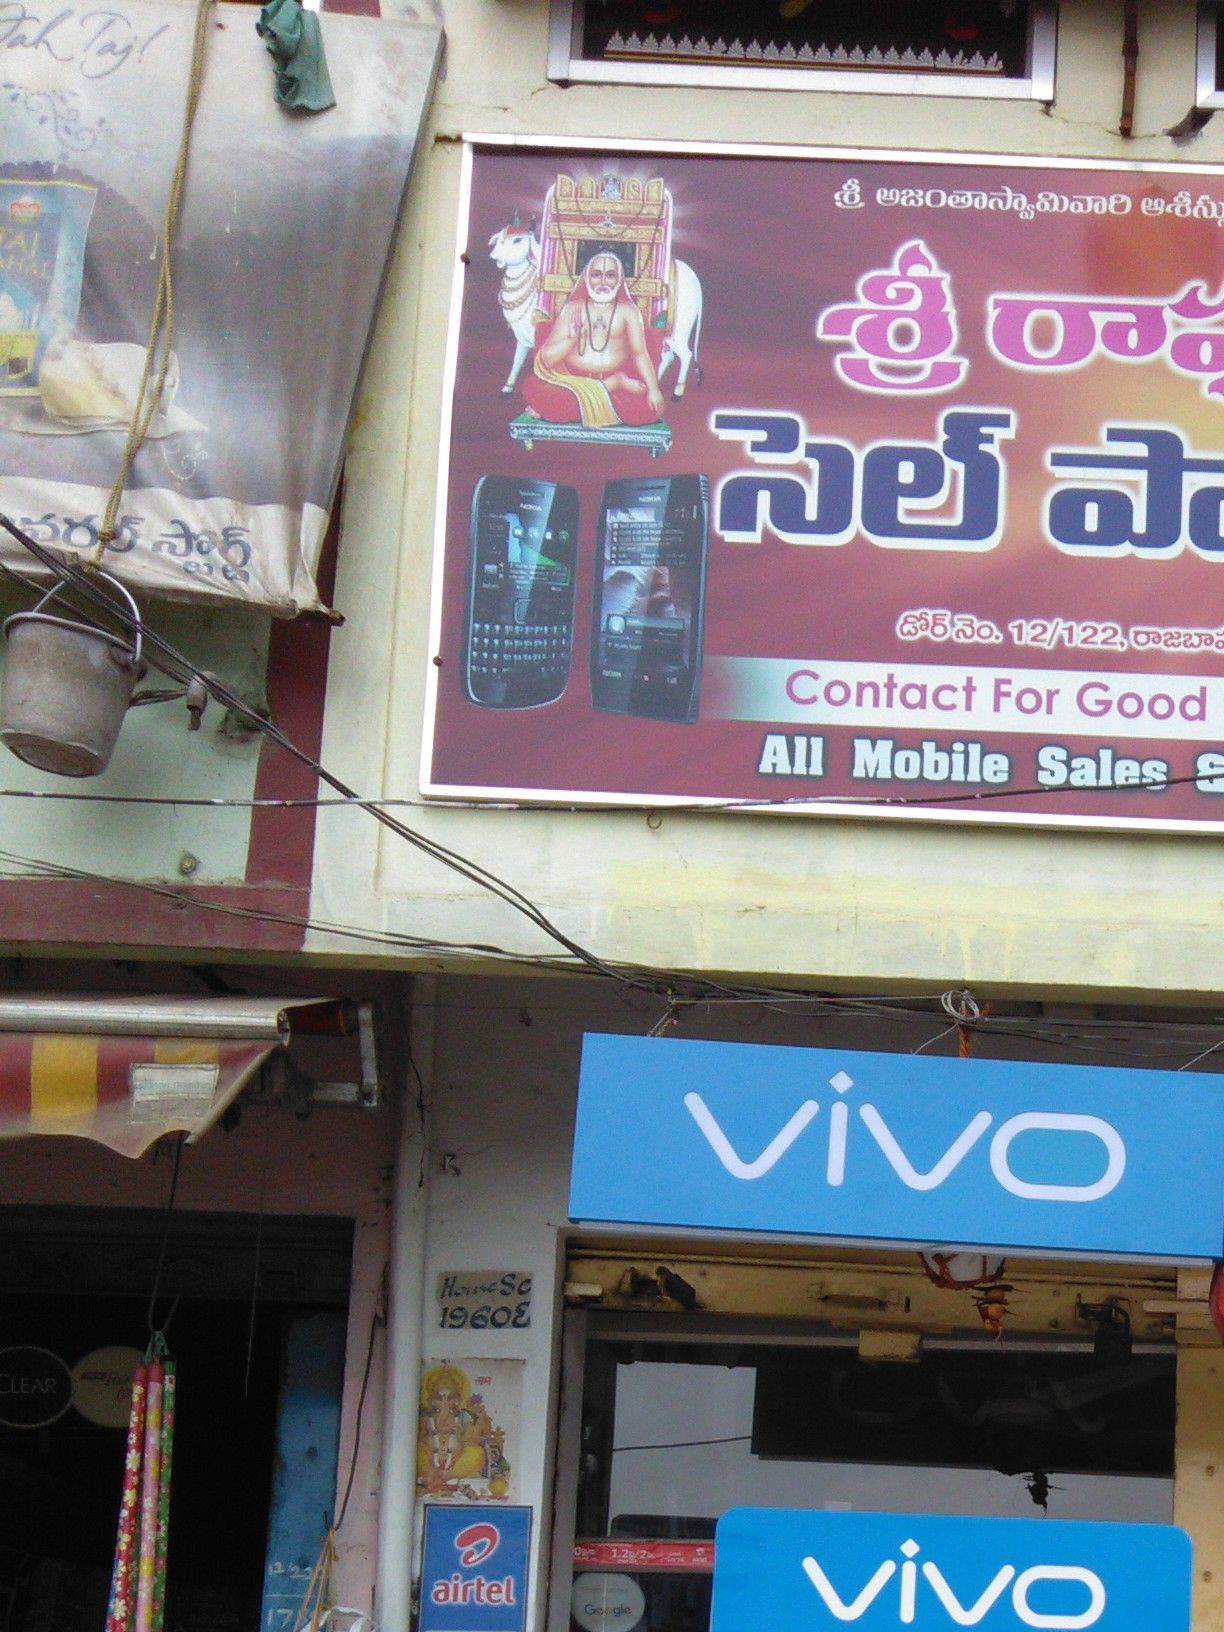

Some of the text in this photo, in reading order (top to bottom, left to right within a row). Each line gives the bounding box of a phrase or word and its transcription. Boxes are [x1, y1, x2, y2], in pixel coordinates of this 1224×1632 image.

[785, 669, 976, 713] Contact
[992, 677, 1062, 715] For
[1075, 680, 1209, 723] Good
[757, 733, 824, 778] All
[851, 739, 1010, 786] Mobile
[1036, 747, 1168, 792] Sales
[683, 1070, 1126, 1203] vivo
[432, 1574, 516, 1605] airtel
[802, 1538, 1105, 1629] vivo
